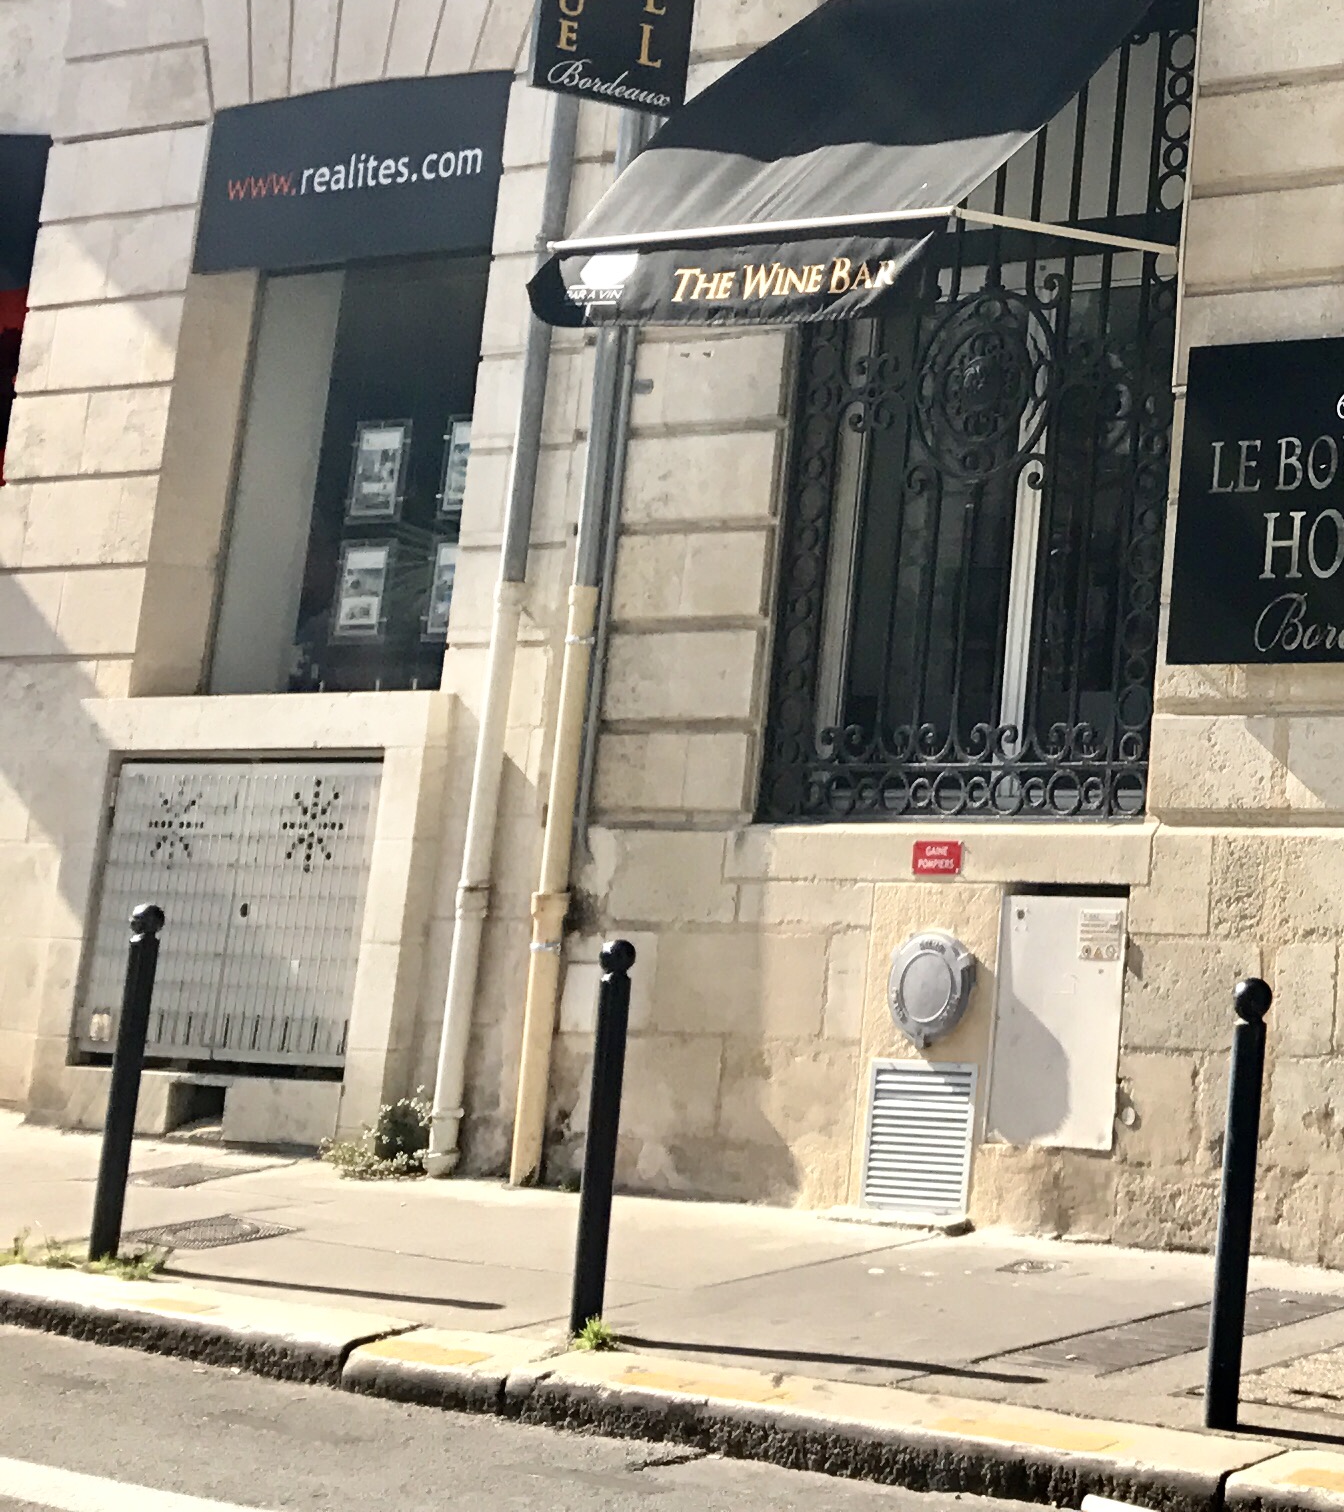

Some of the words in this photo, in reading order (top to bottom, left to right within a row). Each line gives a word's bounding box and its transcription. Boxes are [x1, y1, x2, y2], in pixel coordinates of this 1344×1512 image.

[547, 58, 671, 107] Bordeaux
[227, 146, 483, 201] www.realites.com
[600, 289, 623, 299] VIN
[671, 267, 735, 302] THE
[741, 262, 824, 301] WINE
[827, 256, 896, 295] BAR
[1208, 440, 1261, 494] LE
[918, 858, 954, 869] POMPIERS
